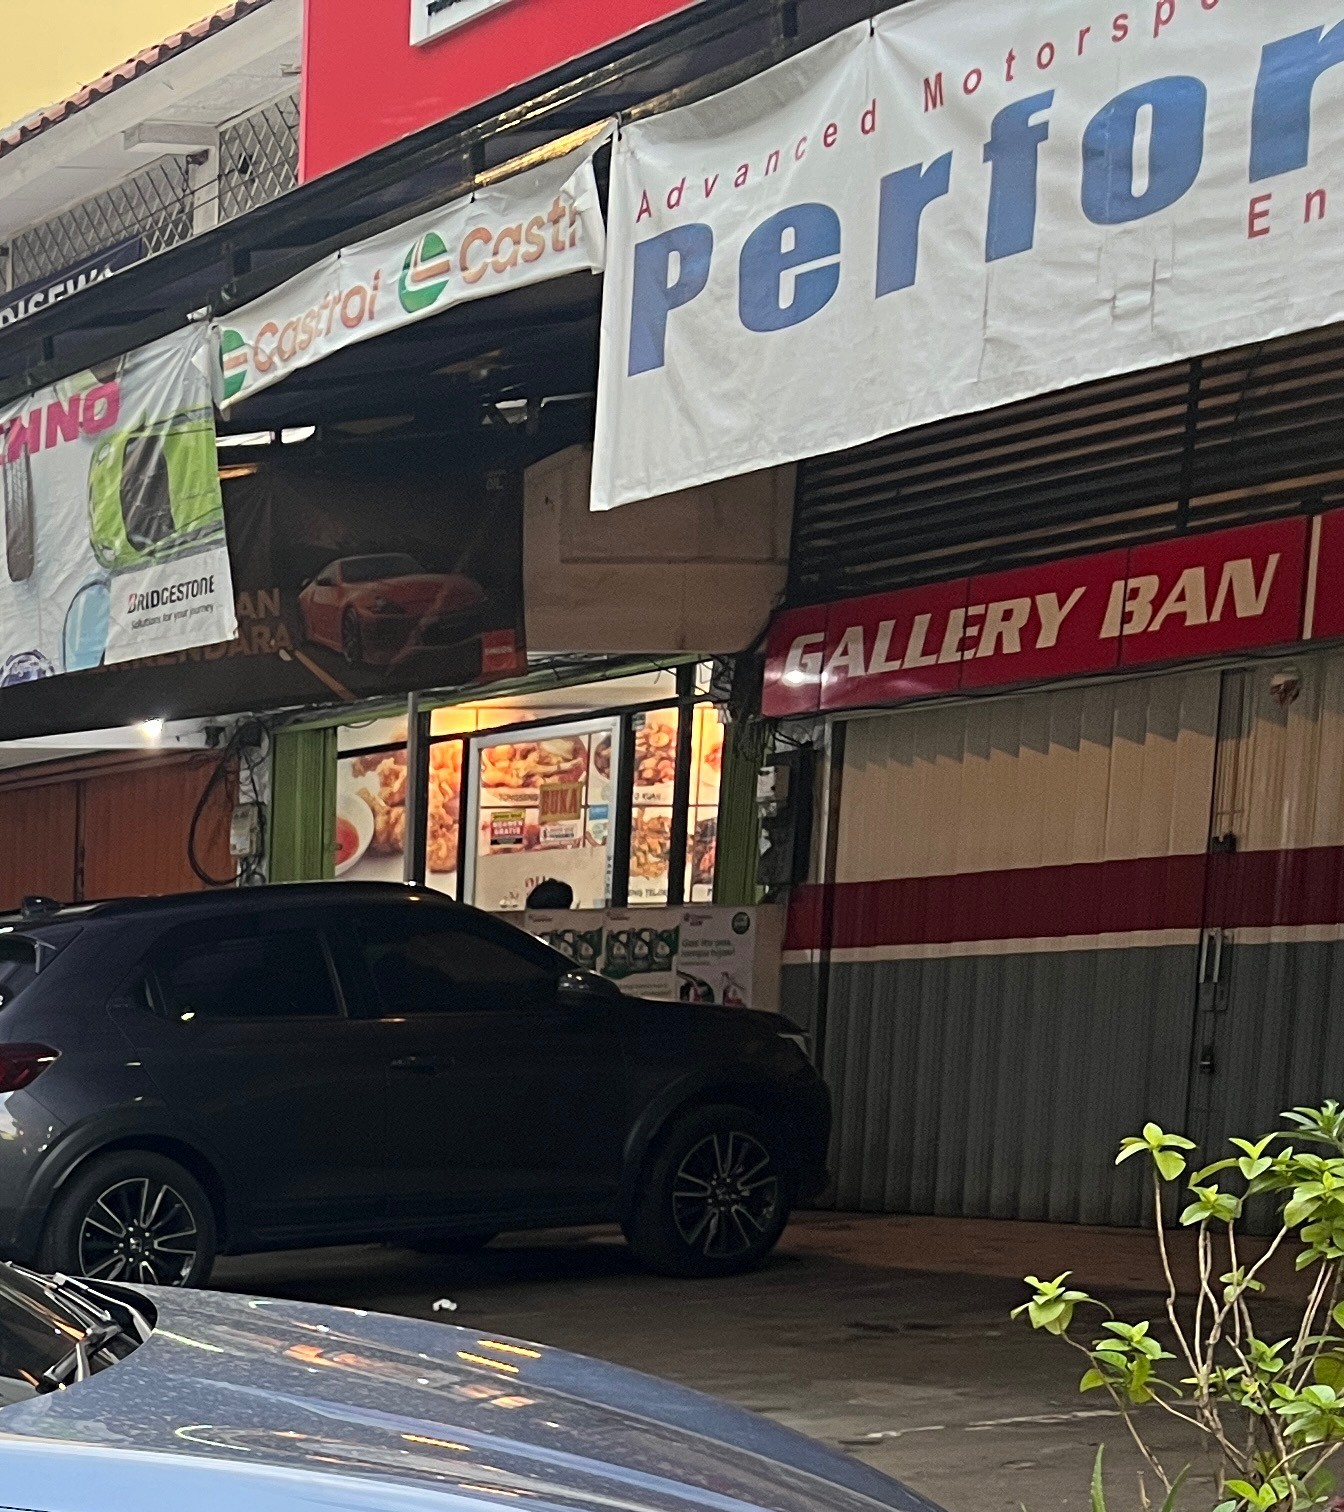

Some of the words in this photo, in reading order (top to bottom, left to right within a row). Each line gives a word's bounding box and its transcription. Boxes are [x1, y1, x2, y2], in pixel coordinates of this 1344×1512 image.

[635, 98, 877, 224] Advanced
[127, 574, 215, 613] BRIDGESTONE
[783, 585, 1089, 687] GALLERY
[1099, 552, 1281, 640] BAN
